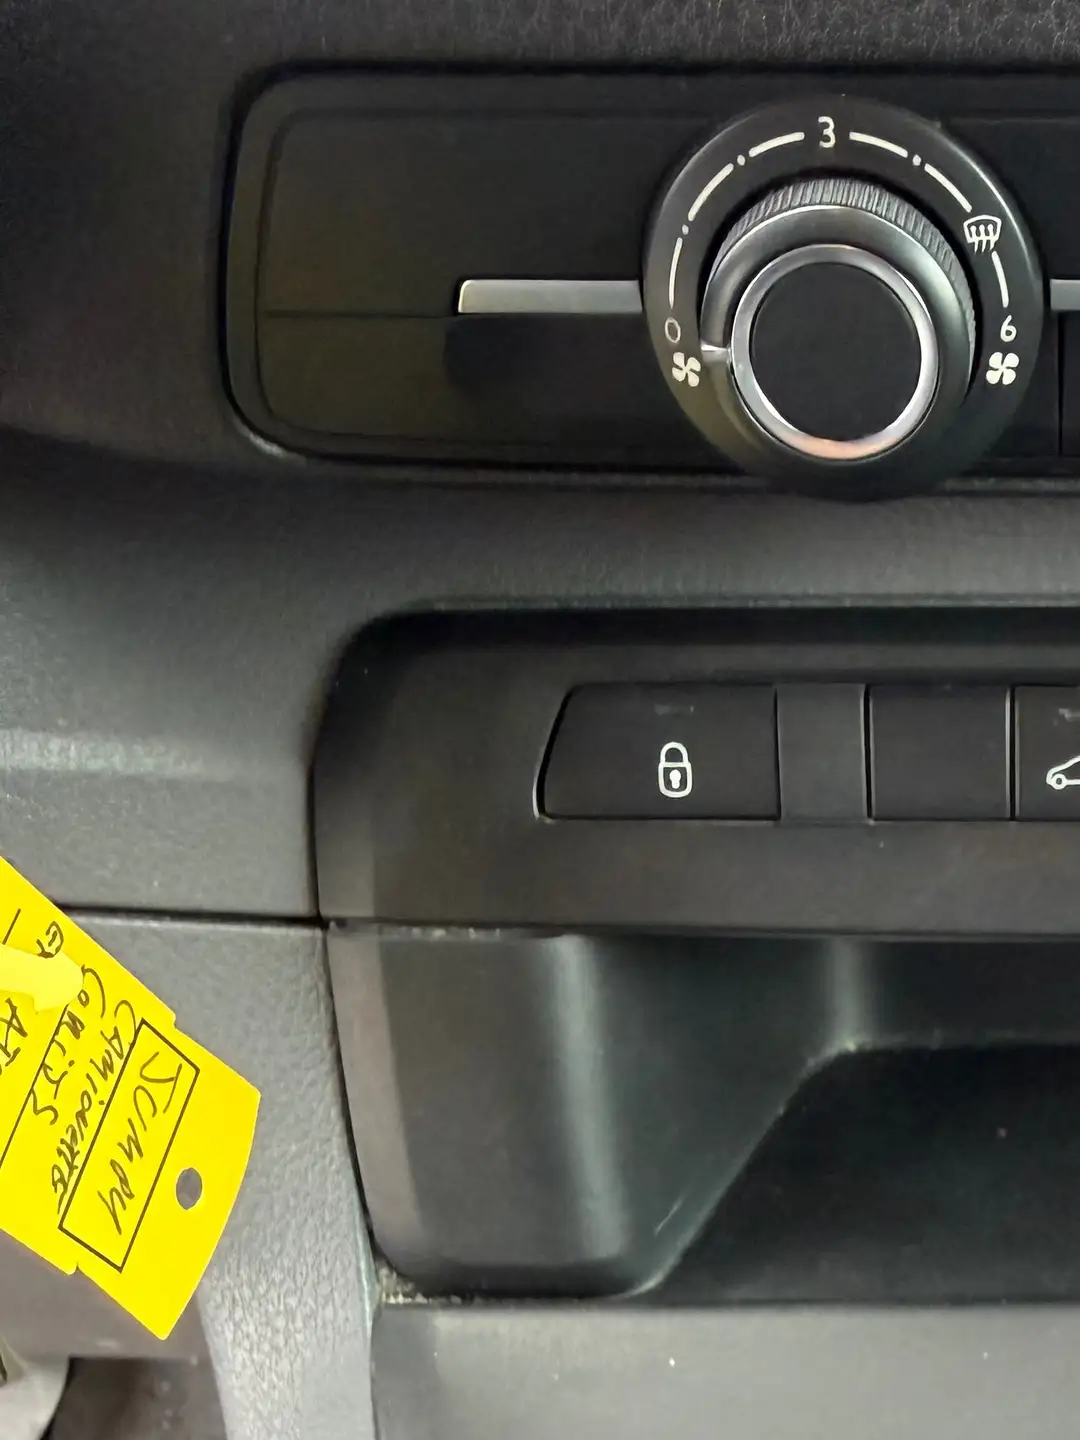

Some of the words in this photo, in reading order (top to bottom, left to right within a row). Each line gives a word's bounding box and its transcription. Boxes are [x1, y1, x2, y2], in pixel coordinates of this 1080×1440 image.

[816, 116, 837, 148] 3
[664, 317, 683, 344] 0
[1000, 315, 1018, 342] 6
